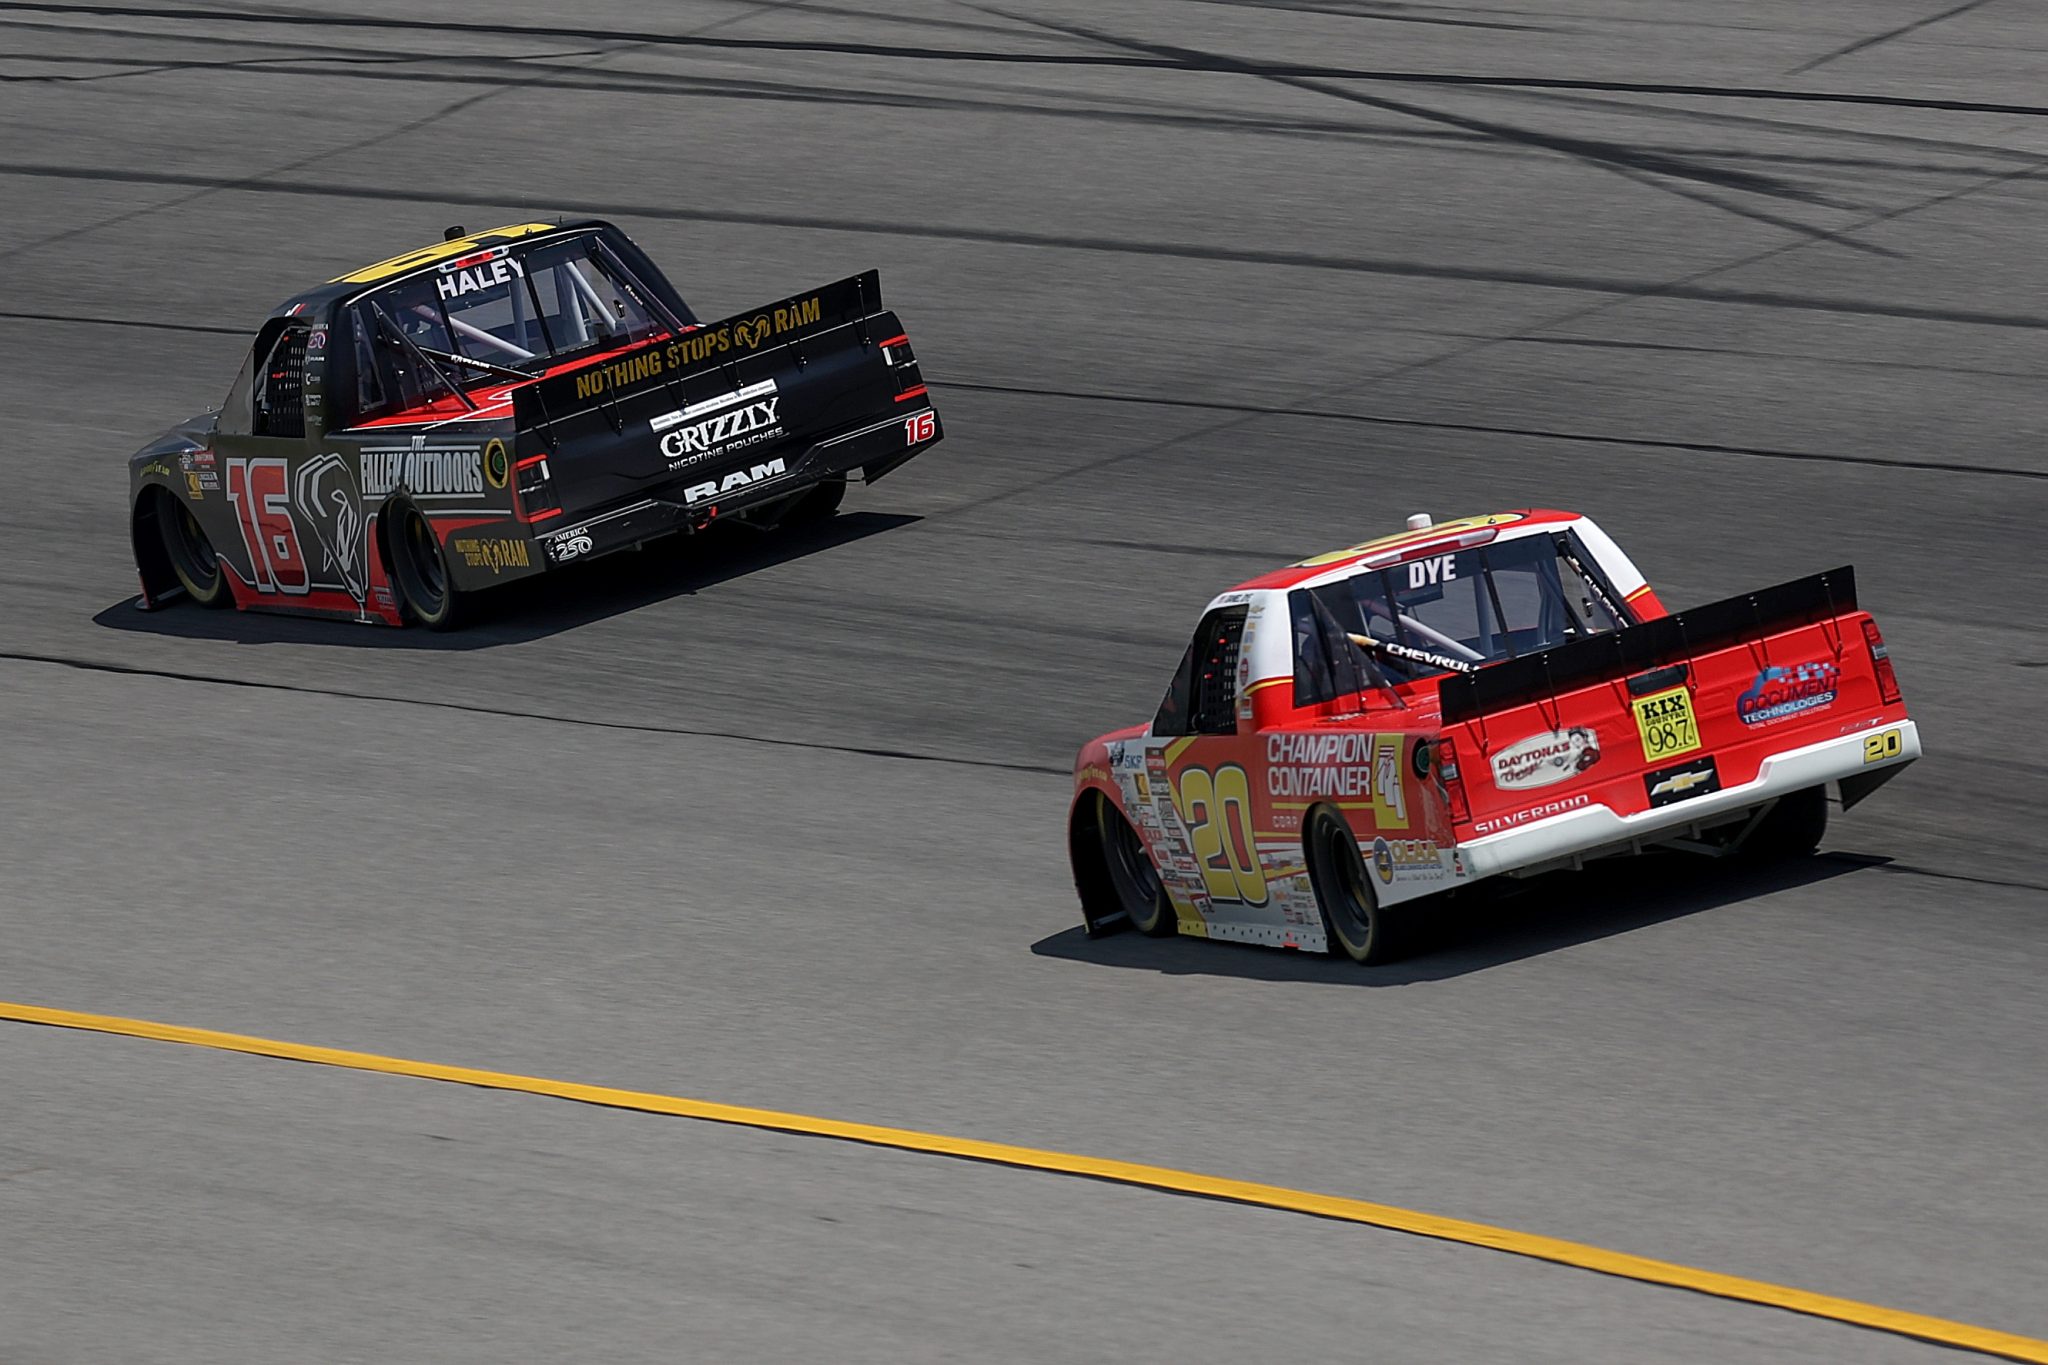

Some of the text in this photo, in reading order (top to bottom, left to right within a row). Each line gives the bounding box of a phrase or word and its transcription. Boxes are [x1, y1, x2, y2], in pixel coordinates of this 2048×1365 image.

[435, 257, 526, 300] HALEY
[576, 297, 821, 399] NOTHING STOPS RAM
[411, 435, 427, 451] THE
[660, 397, 779, 457] GRIZZLY
[905, 410, 935, 446] 16
[668, 426, 784, 471] NICOTINE POUCHES
[360, 452, 484, 494] FALLEN OUTDOORS
[684, 457, 786, 503] RAM
[225, 458, 310, 595] 16
[554, 527, 589, 544] AMERICA
[500, 540, 529, 567] RAM
[556, 535, 593, 561] 250
[1409, 554, 1457, 590] DYE
[1641, 694, 1686, 720] KIX
[1742, 691, 1834, 723] TECHNOLOGIES
[1743, 674, 1840, 713] DOCUMENT
[1645, 709, 1687, 727] COUNTRY
[1648, 718, 1688, 753] 98.7
[1124, 754, 1142, 770] SKF
[1267, 733, 1373, 764] CHAMPION
[1863, 728, 1903, 765] 20
[1267, 766, 1371, 797] CONTAINER
[1271, 815, 1298, 828] CORP
[1474, 795, 1589, 834] SILVERADO
[1179, 761, 1269, 908] 20
